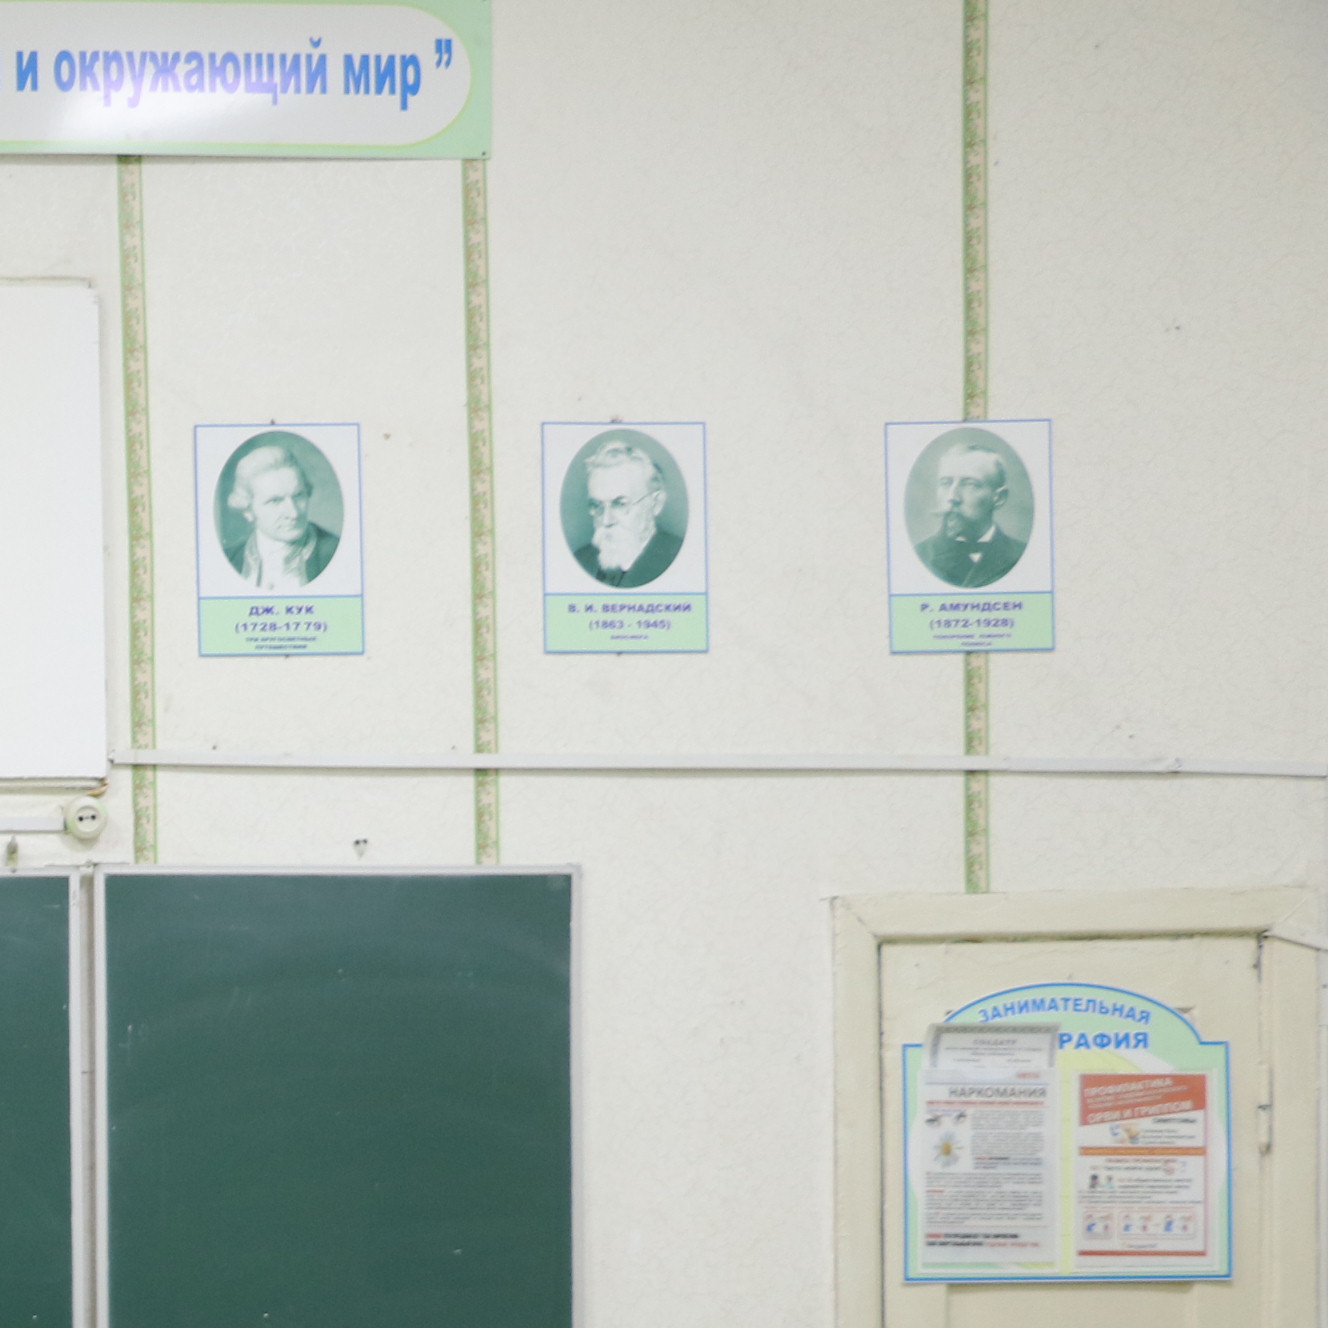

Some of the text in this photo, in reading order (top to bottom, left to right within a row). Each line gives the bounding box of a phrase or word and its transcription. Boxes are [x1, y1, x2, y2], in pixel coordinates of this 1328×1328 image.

[16, 49, 38, 93] и
[54, 37, 328, 108] окружающий
[285, 605, 314, 615] КУК
[938, 601, 1023, 612] АМУНДСЕН
[978, 996, 1152, 1025] ЗАНИМАТЕЛЬНАЯ
[1057, 1031, 1149, 1050] РАФИЯ
